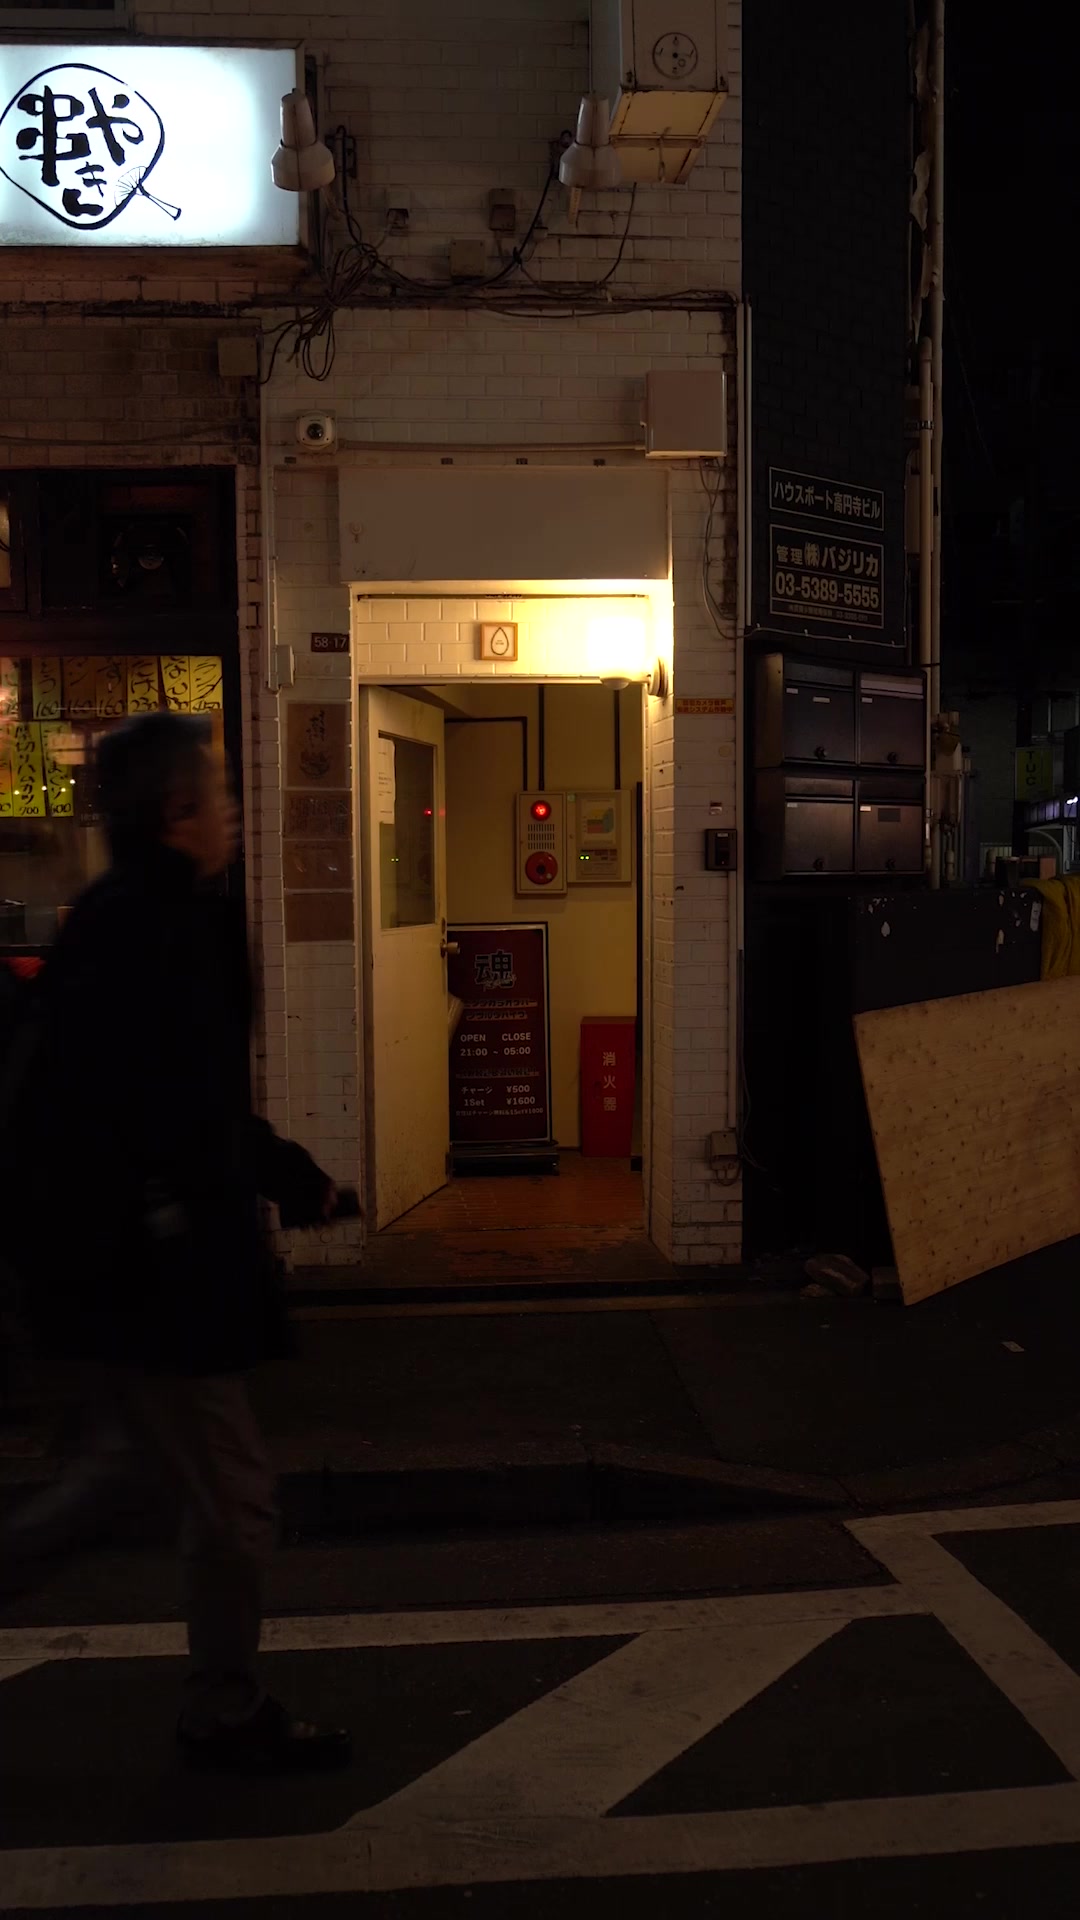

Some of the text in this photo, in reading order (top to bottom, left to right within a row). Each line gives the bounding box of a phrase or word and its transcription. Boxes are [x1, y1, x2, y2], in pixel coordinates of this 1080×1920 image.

[775, 571, 879, 609] 03-5389-5555
[19, 806, 39, 815] 700
[460, 1032, 531, 1043] OPEN CLOSE
[460, 1047, 488, 1057] 21:00
[503, 1046, 531, 1056] 05:00
[602, 1050, 617, 1112] 消火器
